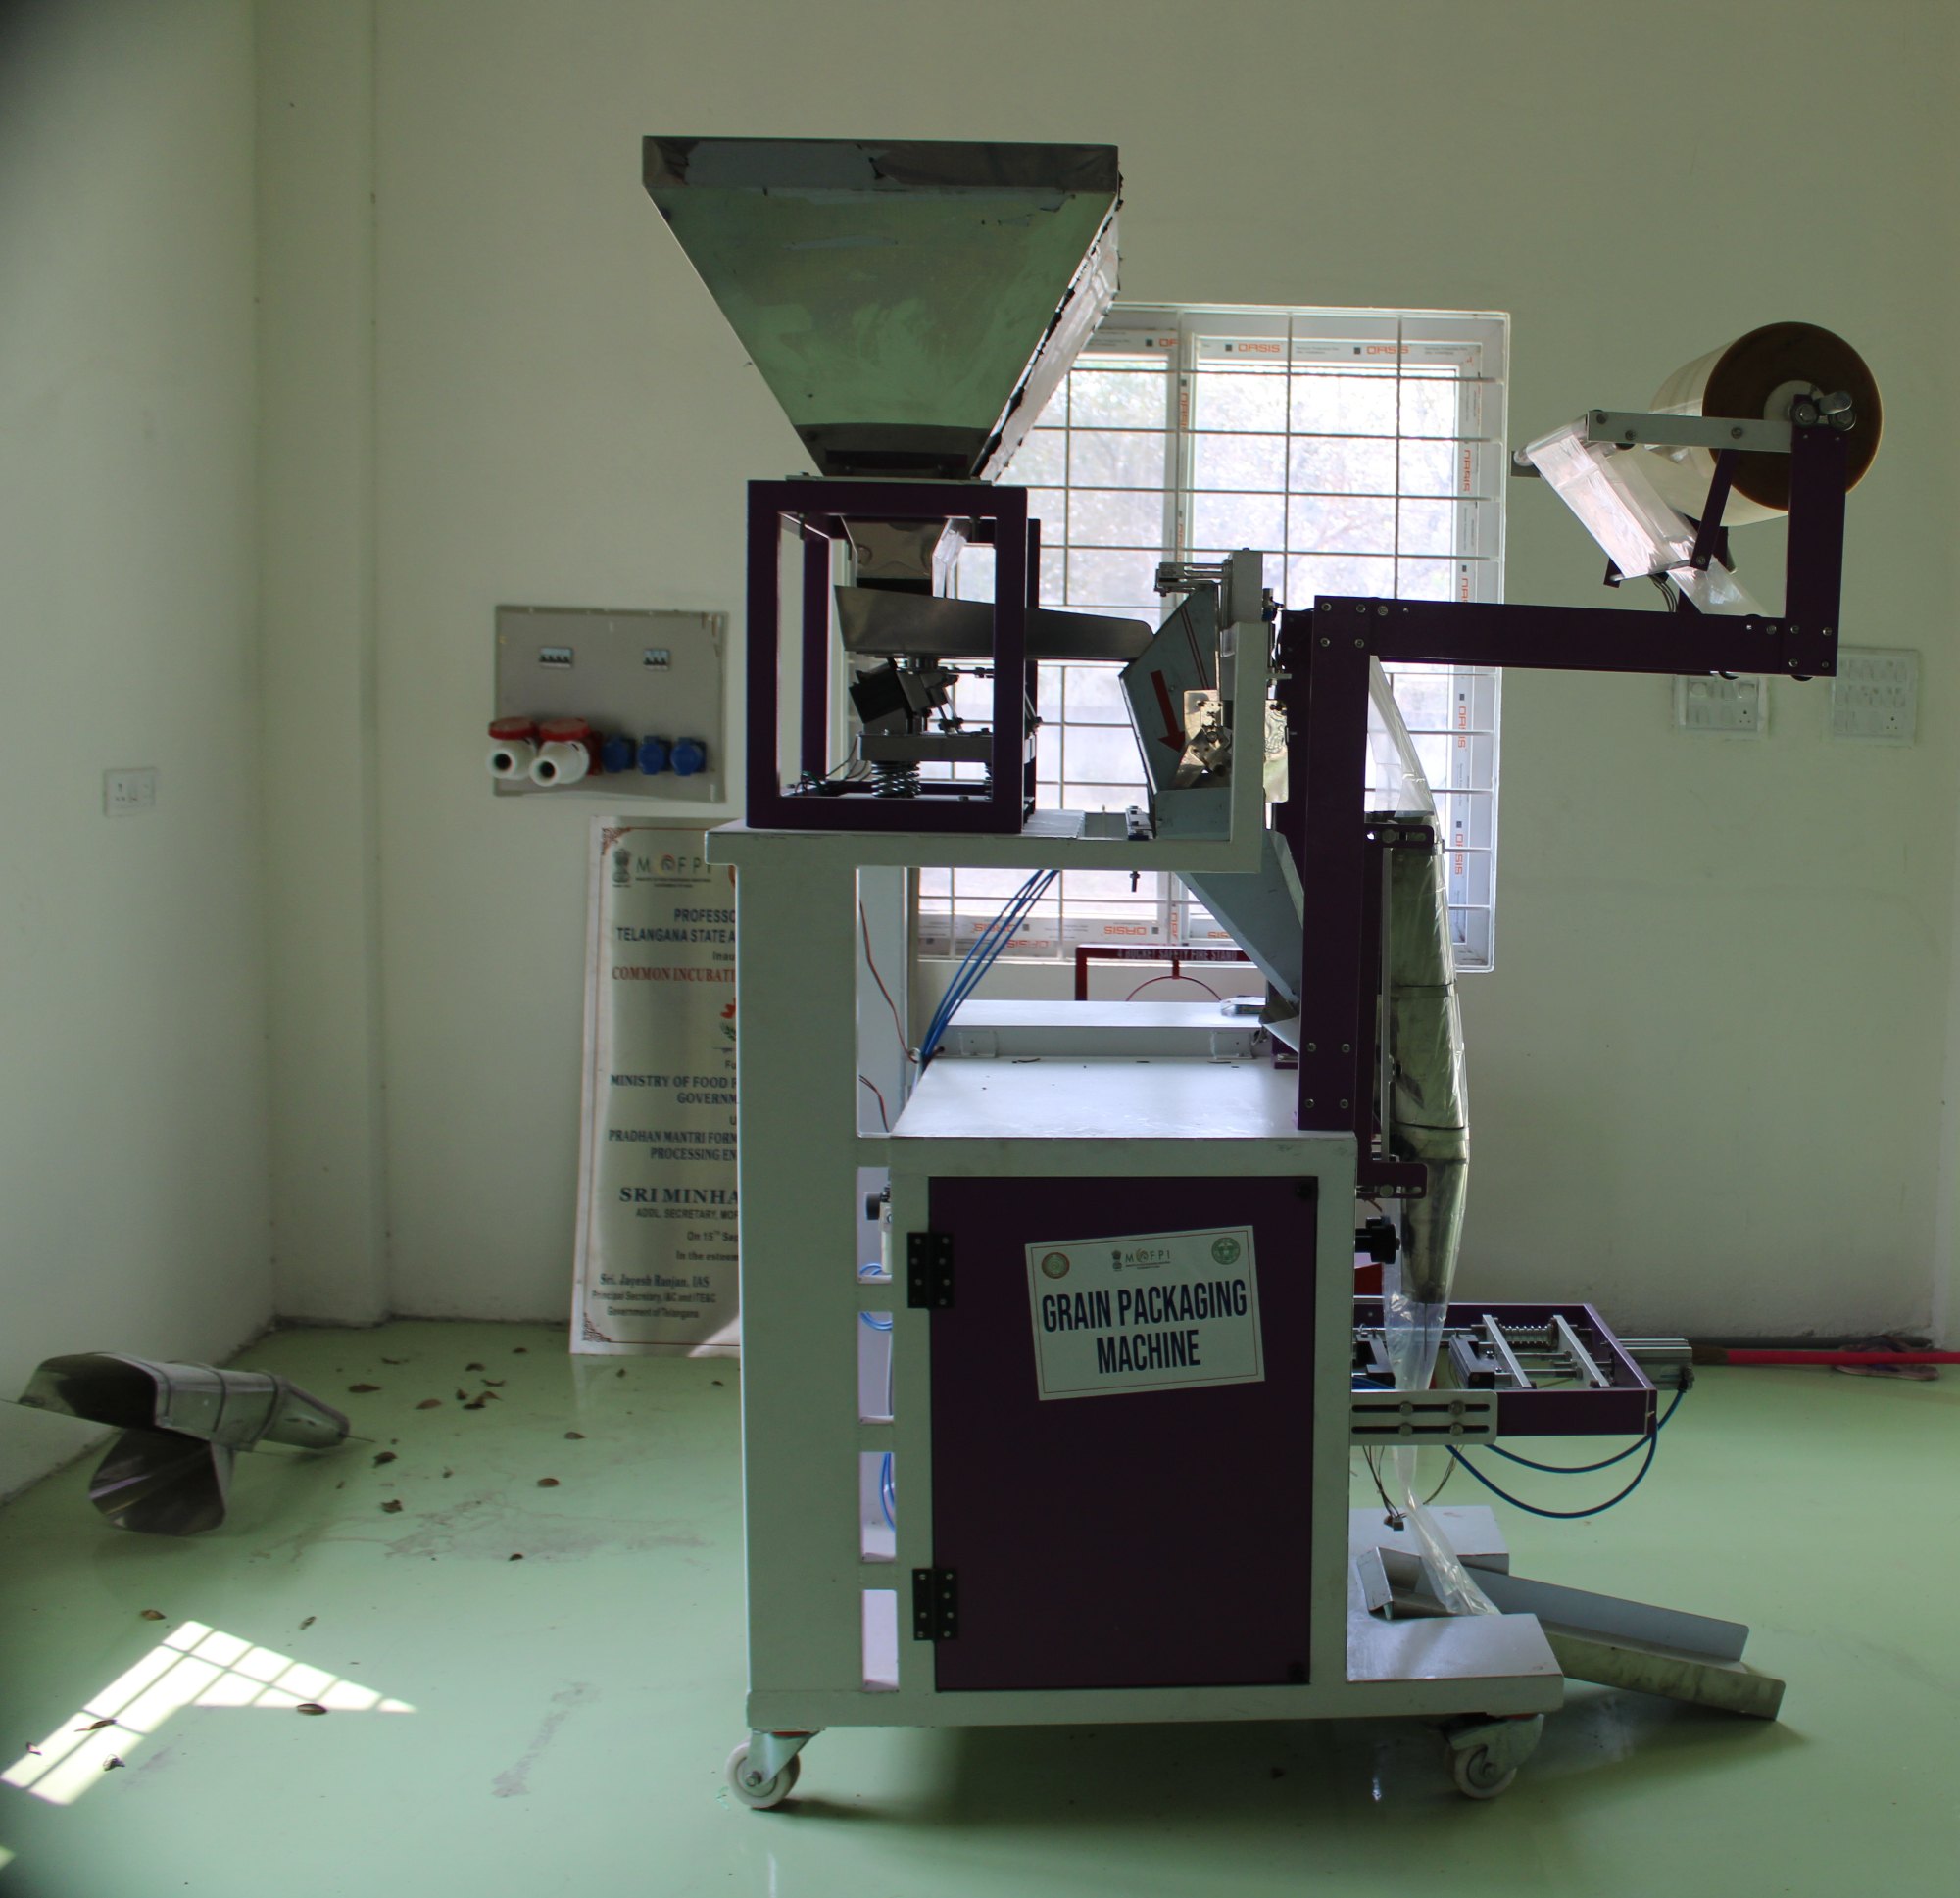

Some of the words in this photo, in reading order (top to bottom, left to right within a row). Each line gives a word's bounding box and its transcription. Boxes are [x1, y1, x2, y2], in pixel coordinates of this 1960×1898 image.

[1366, 345, 1409, 355] OASS
[616, 927, 688, 942] TELANGANA
[690, 929, 725, 943] STATE
[612, 966, 670, 981] COMMON
[610, 1074, 670, 1088] MINISTRY
[672, 1076, 690, 1088] OF
[693, 1076, 728, 1089] FOOD
[609, 1129, 661, 1142] PRADHAN
[663, 1131, 705, 1144] MANTRI
[650, 1147, 720, 1161] PROCESSING
[619, 1187, 658, 1203] SRI
[1042, 1290, 1112, 1333] GRAIN
[1117, 1279, 1248, 1327] PACKAGING
[1096, 1329, 1201, 1374] MACHINE
